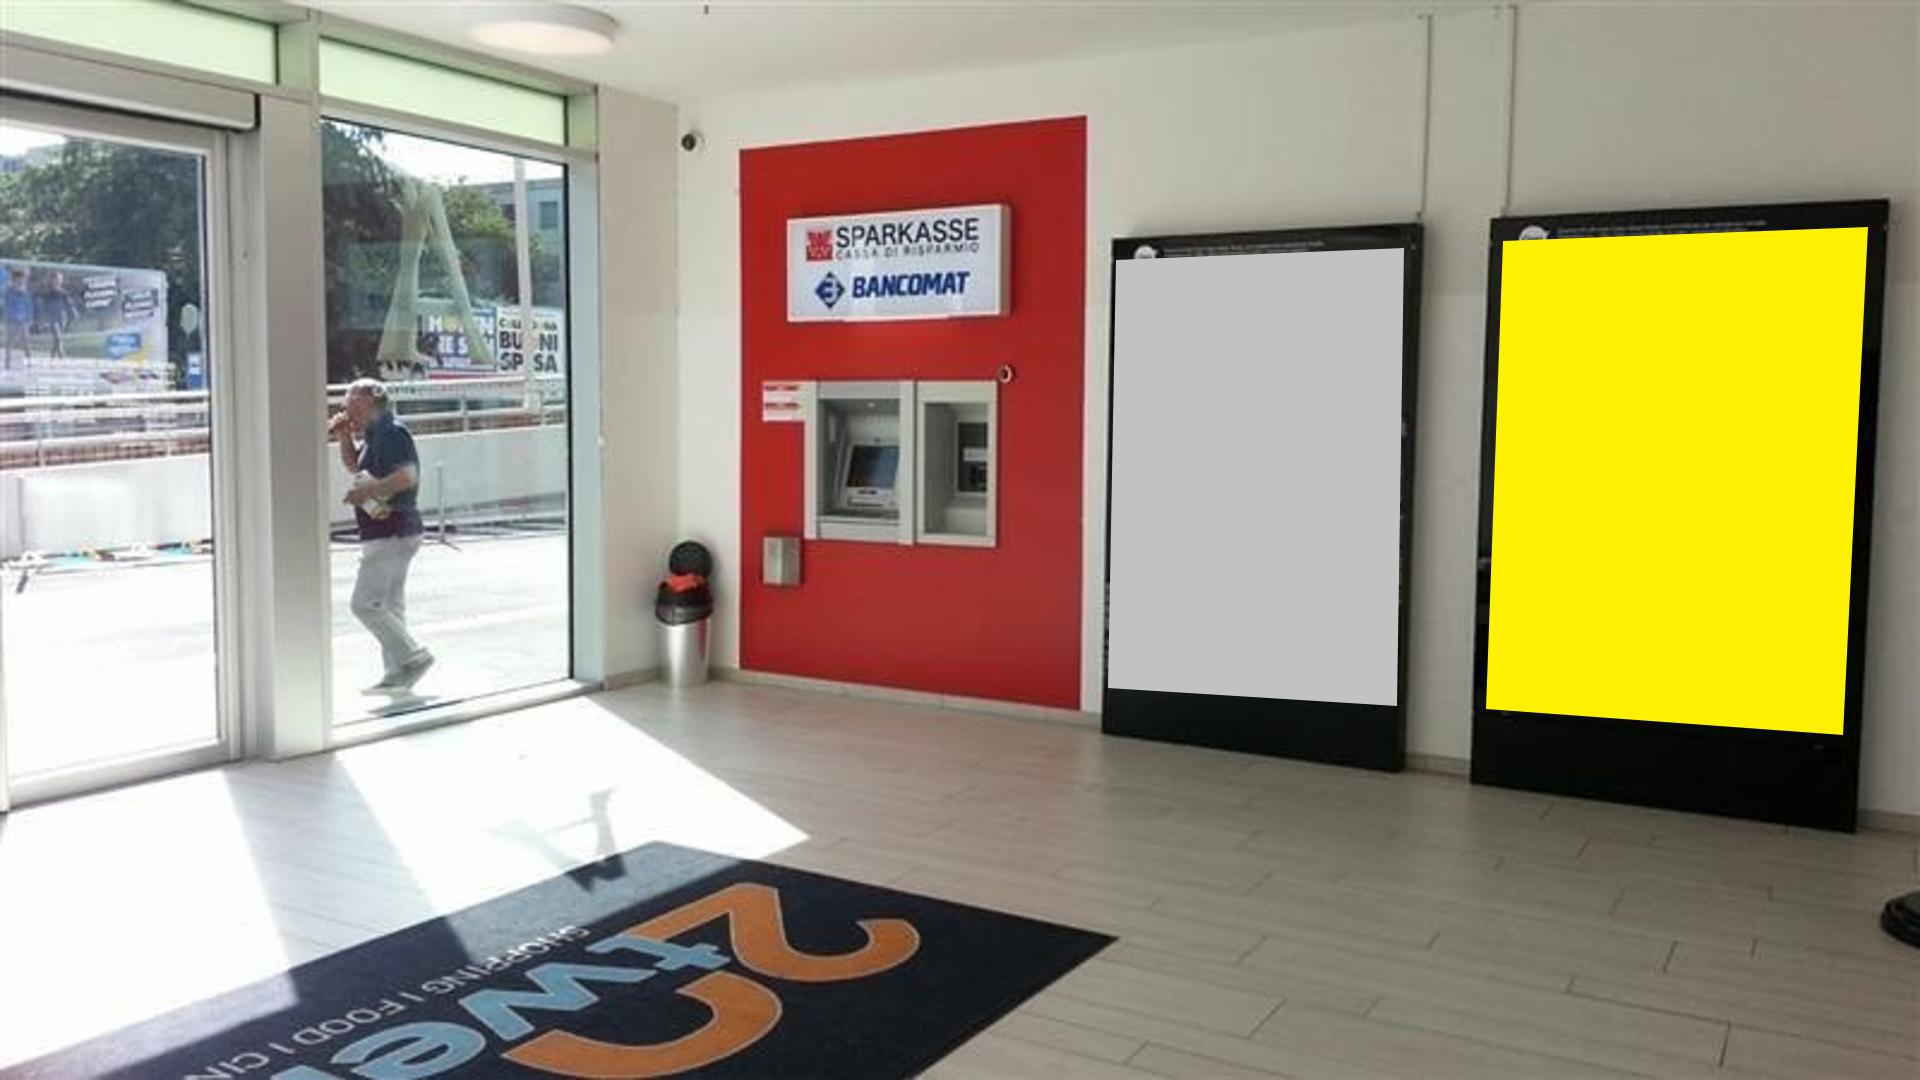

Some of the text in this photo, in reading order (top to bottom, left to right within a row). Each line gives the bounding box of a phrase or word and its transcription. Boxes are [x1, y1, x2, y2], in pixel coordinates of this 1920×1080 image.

[836, 218, 980, 249] SPARKASSE
[835, 242, 980, 260] CASSA DI RISPARMIO
[852, 271, 970, 299] BANCOMAT
[500, 331, 558, 352] BUNI
[500, 352, 558, 373] SPSA
[421, 925, 591, 996] SHOPPING
[293, 1001, 406, 1046] FOOD
